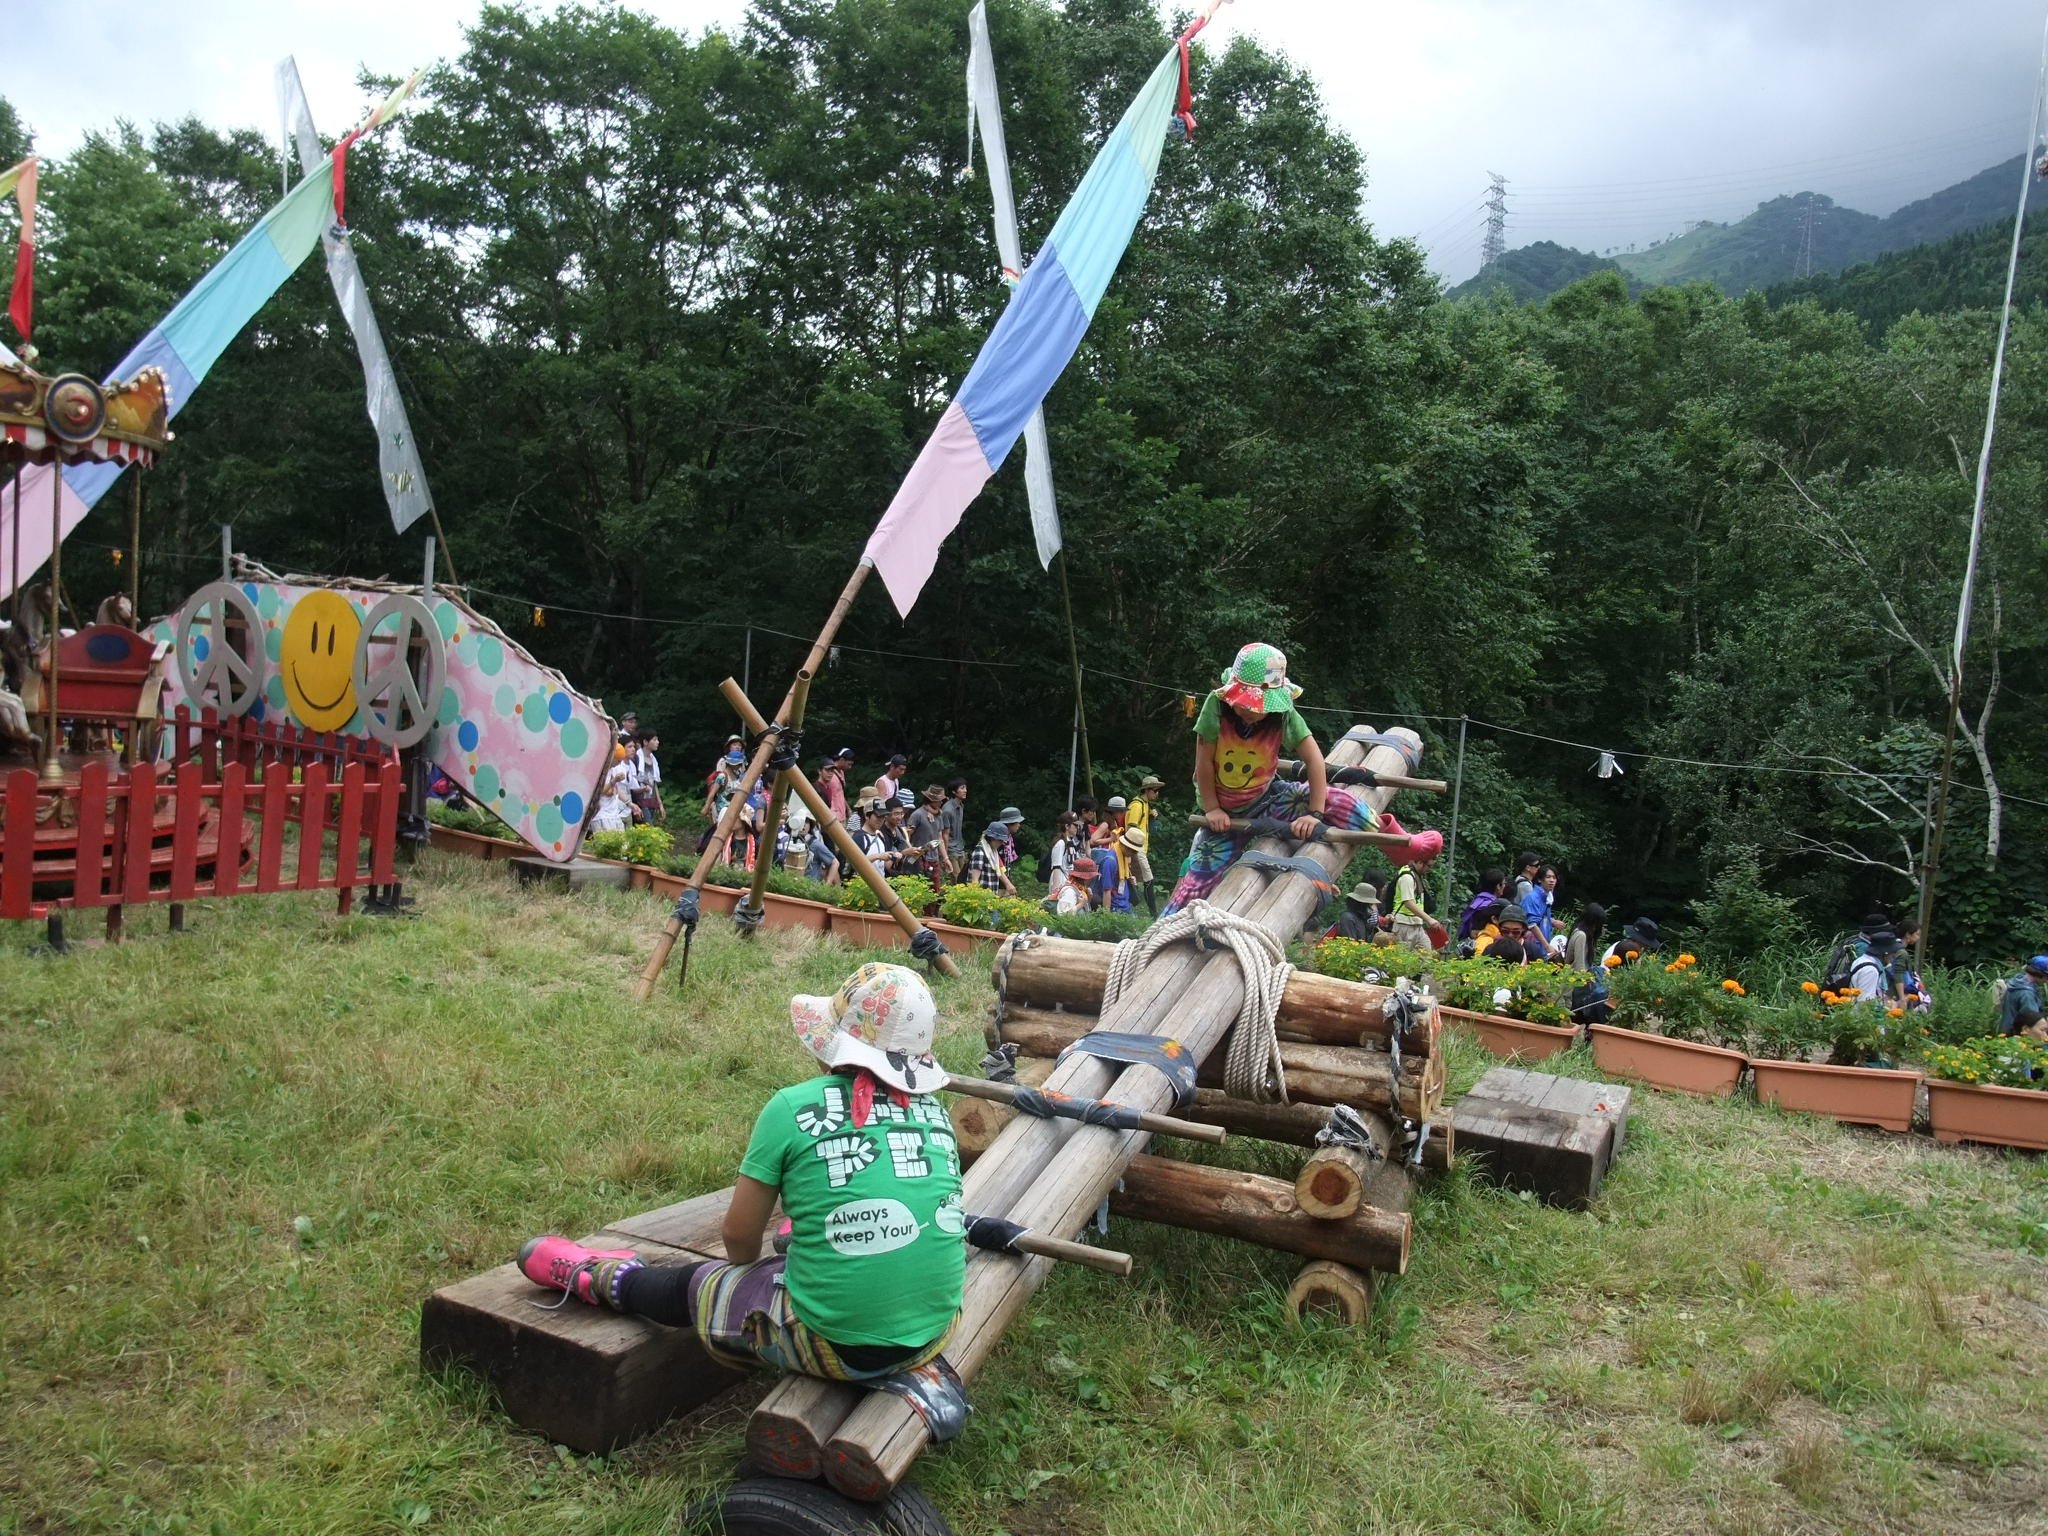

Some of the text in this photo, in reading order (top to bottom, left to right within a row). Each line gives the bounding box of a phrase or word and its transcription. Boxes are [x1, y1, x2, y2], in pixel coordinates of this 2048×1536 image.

[832, 1208, 889, 1226] Always
[833, 1223, 914, 1244] Keep Your
